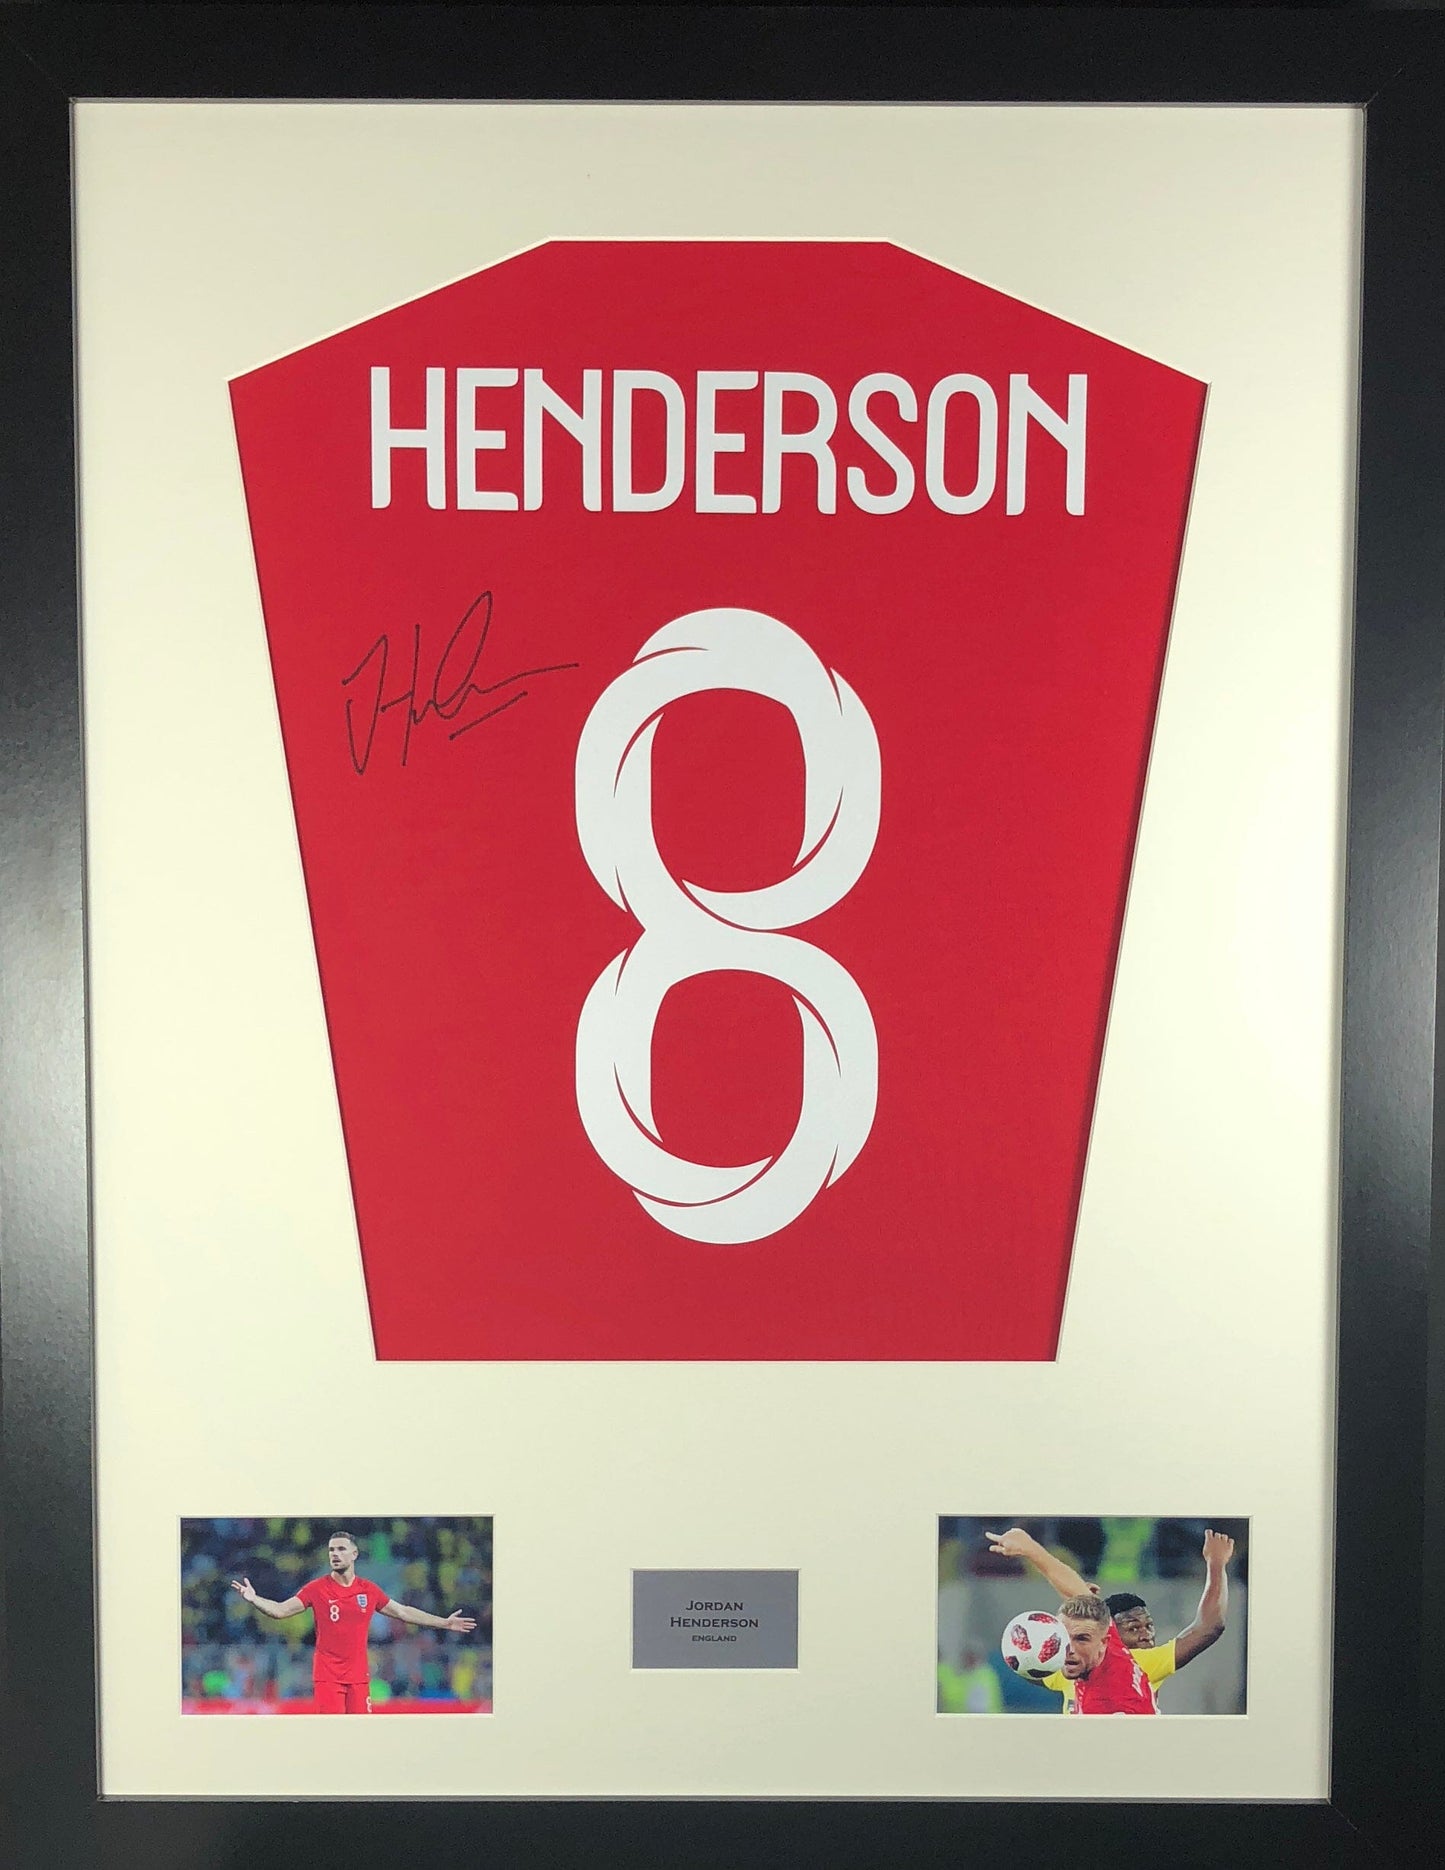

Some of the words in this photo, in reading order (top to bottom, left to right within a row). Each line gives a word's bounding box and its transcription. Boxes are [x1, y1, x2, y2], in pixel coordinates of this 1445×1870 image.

[371, 367, 1088, 516] HENDERSON
[575, 608, 882, 1245] 8
[330, 1604, 340, 1622] 8
